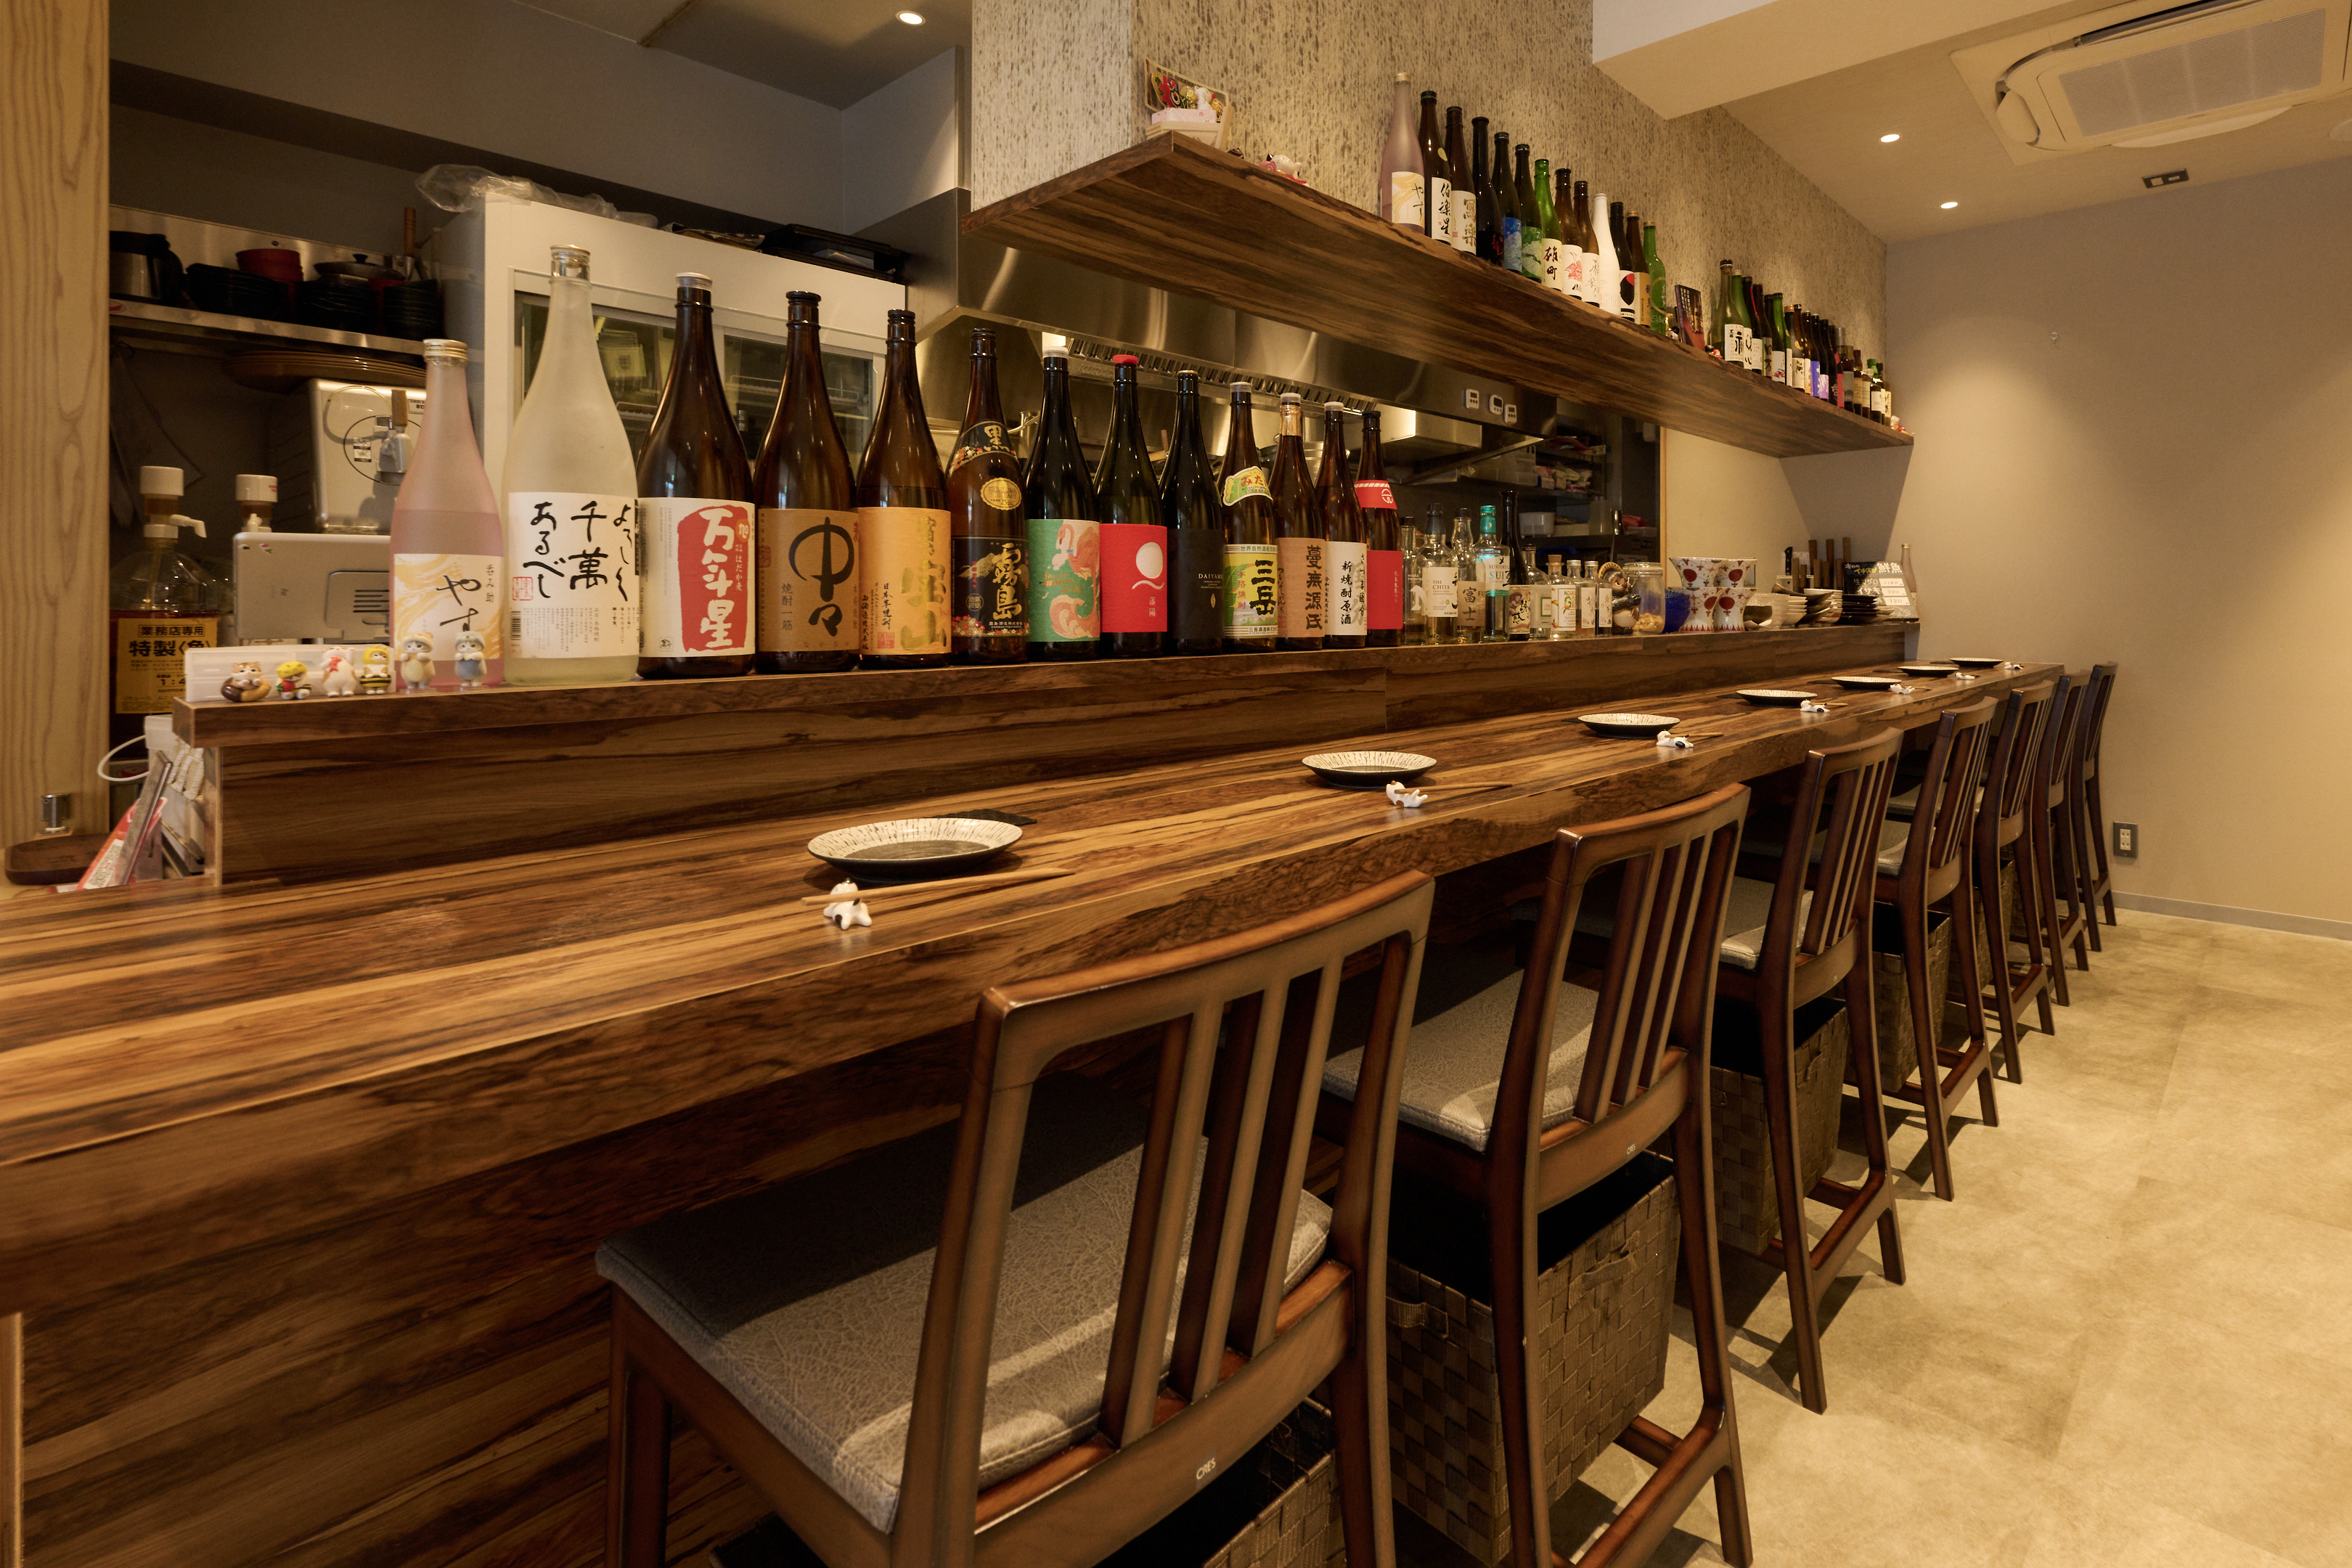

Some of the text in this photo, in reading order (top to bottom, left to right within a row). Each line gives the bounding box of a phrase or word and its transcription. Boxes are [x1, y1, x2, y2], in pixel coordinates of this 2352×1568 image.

[1543, 246, 1558, 280] 雄町
[984, 425, 1010, 452] 黒
[992, 542, 1022, 621] 霧島
[1877, 562, 1903, 573] 鮮魚
[1249, 560, 1277, 616] 三岳
[1304, 544, 1323, 630] 蔓無源氏
[1340, 560, 1352, 624] 新焼酎原酒
[1462, 586, 1477, 621] 富士
[781, 583, 793, 631] 焼酎一筋
[141, 626, 204, 637] 業務店専用
[1196, 1457, 1217, 1480] CRES
